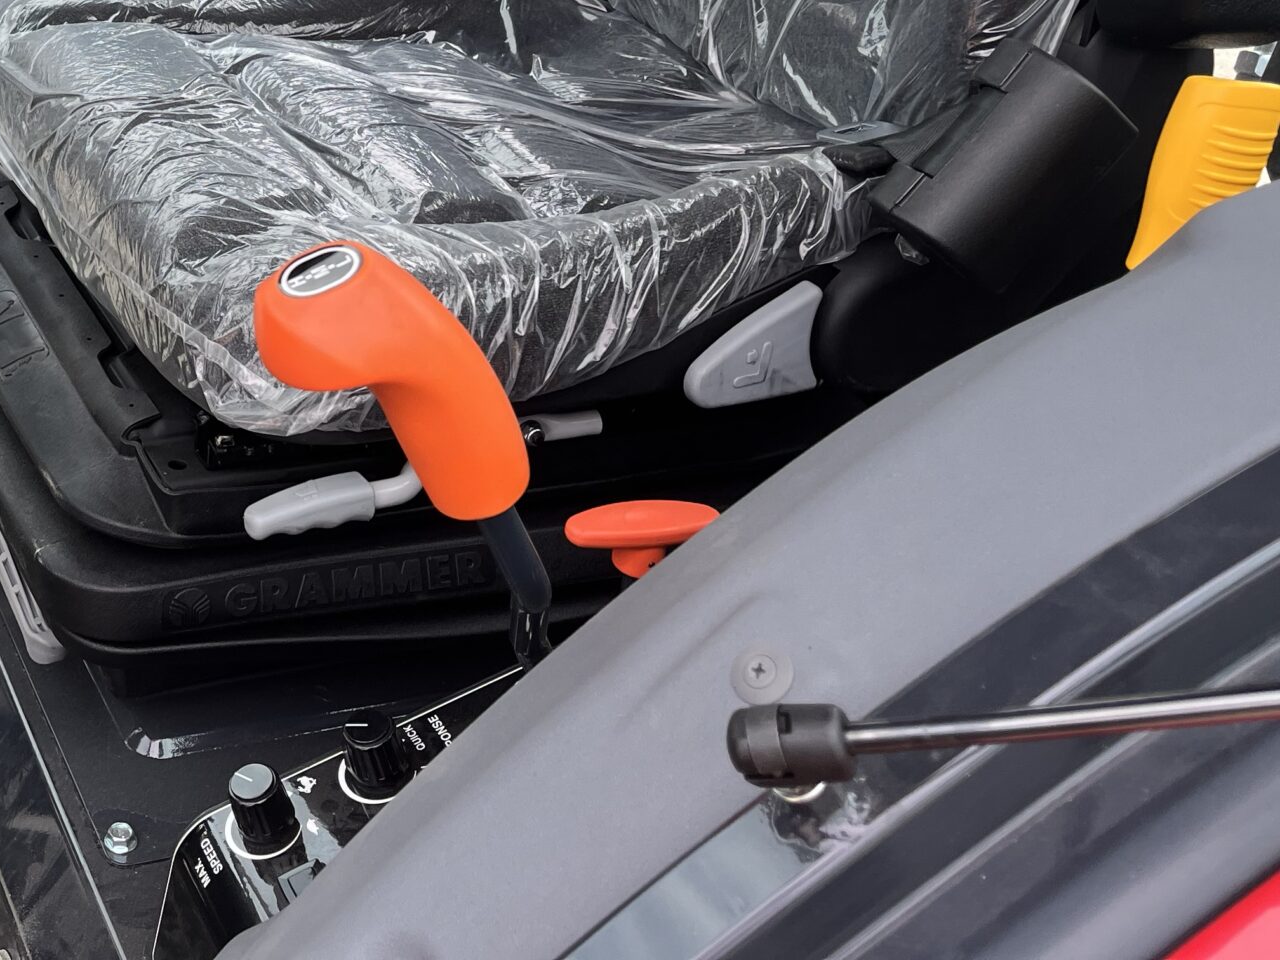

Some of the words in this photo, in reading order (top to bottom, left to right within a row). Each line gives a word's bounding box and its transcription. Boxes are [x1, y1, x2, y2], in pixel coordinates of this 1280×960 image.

[224, 550, 487, 618] GRAMMER
[402, 723, 426, 752] QUICK
[194, 857, 212, 889] MAX.
[199, 837, 224, 876] SPEED
